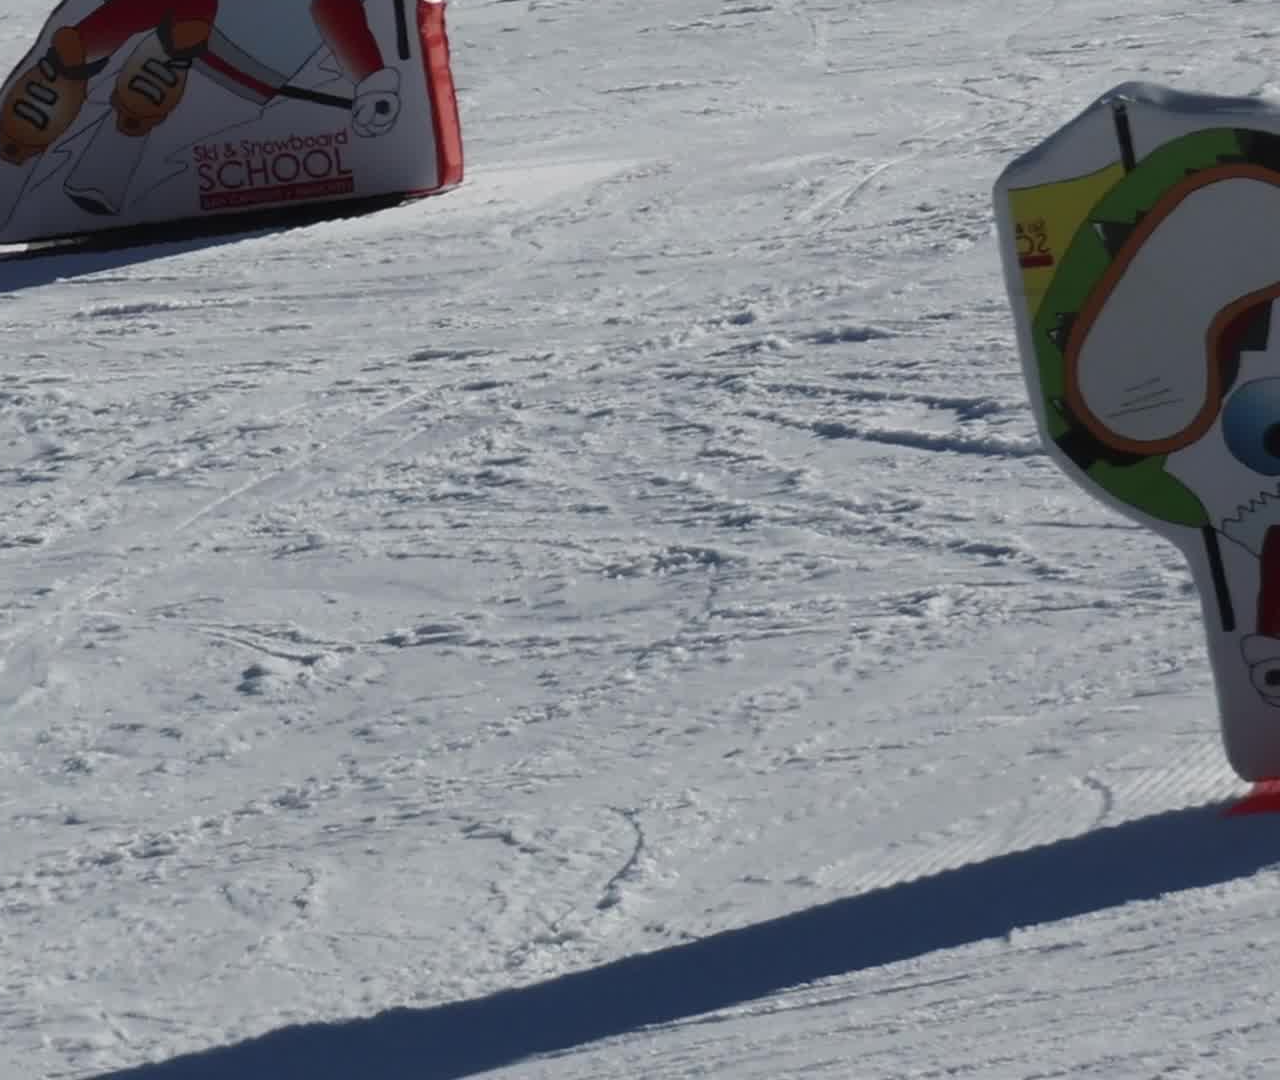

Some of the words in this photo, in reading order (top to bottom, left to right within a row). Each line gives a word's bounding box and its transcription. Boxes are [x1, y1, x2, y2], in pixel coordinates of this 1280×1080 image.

[193, 143, 218, 163] Ski
[224, 143, 237, 159] &
[241, 128, 348, 157] Snowboard
[198, 147, 353, 192] SCHOOL
